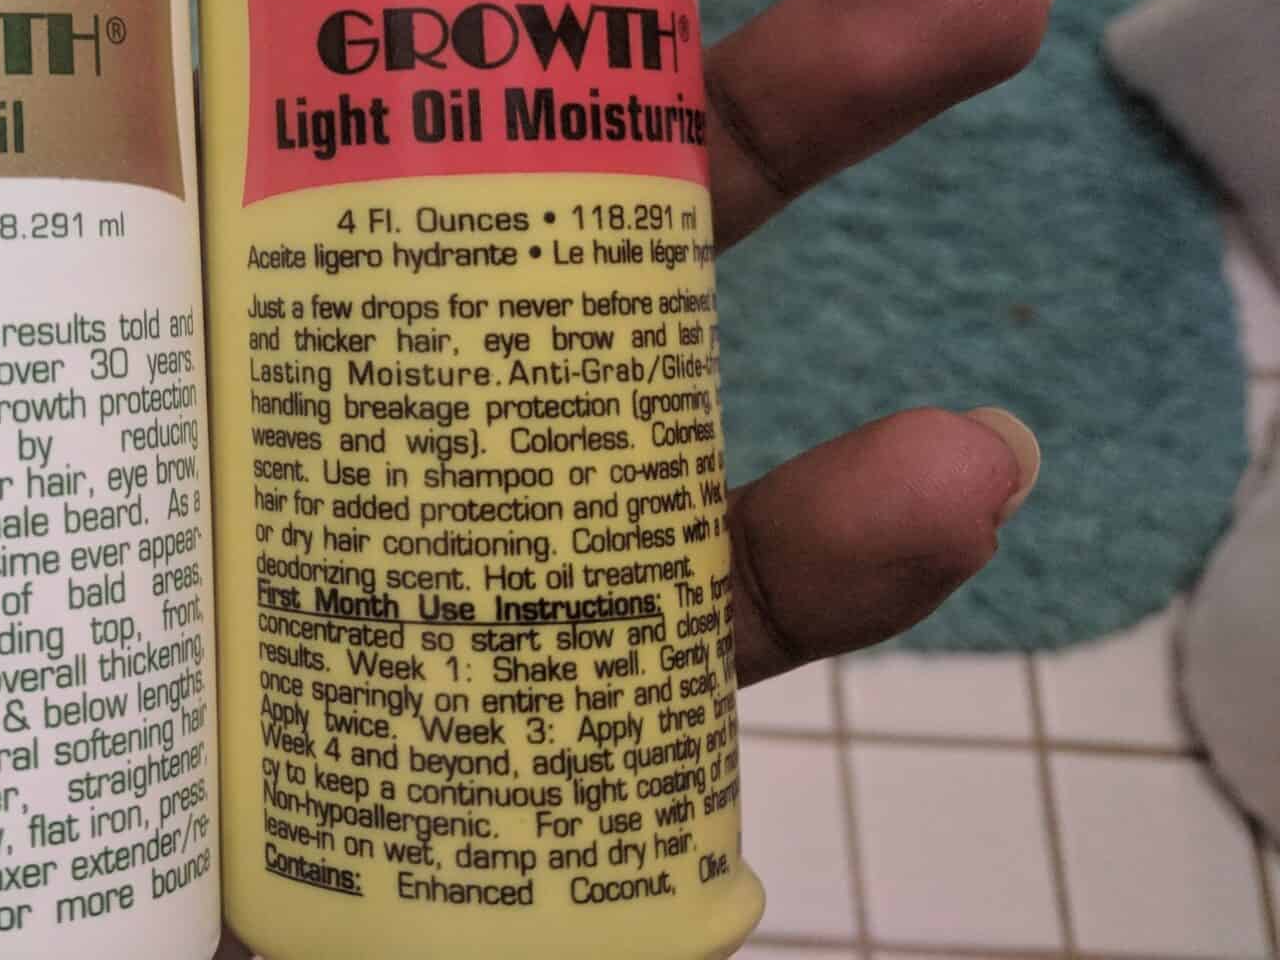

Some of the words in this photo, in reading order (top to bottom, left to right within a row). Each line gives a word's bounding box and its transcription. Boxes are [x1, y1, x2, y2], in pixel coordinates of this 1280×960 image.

[275, 95, 391, 160] Light
[413, 88, 481, 143] Oil
[505, 86, 706, 148] Moisturize
[99, 212, 125, 236] ml
[337, 209, 356, 234] 4
[369, 208, 400, 234] Fl.
[416, 207, 529, 233] Ounces
[572, 204, 673, 230] 118.291
[248, 244, 305, 270] Aceite
[314, 243, 382, 275] ligero
[393, 242, 517, 274] hydrante
[593, 239, 643, 264] huile
[651, 239, 688, 270] léger
[2, 313, 106, 347] results
[119, 308, 159, 340] told
[248, 293, 285, 319] Just
[361, 294, 439, 325] drops
[499, 298, 573, 318] never
[582, 291, 652, 317] before
[295, 328, 376, 352] thicker
[397, 328, 459, 356] hair,
[552, 324, 614, 351] brow
[250, 358, 331, 391] Lasting
[348, 360, 501, 386] Moisture.
[100, 379, 196, 425] protection
[250, 389, 331, 425] handling
[344, 394, 469, 427] breakage
[486, 392, 620, 426] protection
[122, 415, 197, 452] reducing
[252, 427, 322, 450] weaves
[407, 428, 486, 461] wigs).
[511, 424, 634, 454] Colorless.
[254, 459, 308, 482] scent.
[323, 459, 370, 485] Use
[424, 463, 553, 493] shampoo
[610, 453, 688, 483] co-wash
[65, 495, 148, 533] beard.
[254, 485, 287, 512] hair
[294, 489, 324, 516] for
[333, 494, 409, 520] added
[421, 495, 562, 527] protection
[573, 492, 618, 520] and
[627, 485, 695, 522] growth.
[71, 541, 130, 571] ever
[282, 522, 312, 554] dry
[324, 525, 370, 552] hair
[383, 530, 556, 562] conditioning.
[573, 525, 674, 553] Colorless
[68, 572, 125, 610] bald
[256, 552, 375, 593] deodorizing
[386, 567, 470, 590] scent.
[485, 564, 536, 590] Hot
[546, 563, 573, 589] oil
[584, 556, 694, 588] treatment.
[257, 578, 301, 609] First
[316, 587, 398, 618] Month
[419, 594, 475, 621] Use
[496, 591, 661, 621] Instructions:
[258, 613, 403, 649] concentrated
[472, 629, 541, 651] start
[557, 621, 614, 650] slow
[628, 623, 666, 646] and
[259, 641, 330, 672] results.
[347, 649, 426, 680] Week
[493, 656, 577, 683] Shake
[594, 649, 645, 679] well.
[44, 692, 127, 728] below
[260, 671, 303, 696] once
[312, 680, 422, 718] sparingly
[482, 687, 564, 713] entire
[575, 683, 624, 711] hair
[634, 678, 672, 706] and
[261, 694, 309, 733] Apply
[324, 710, 397, 739] twice.
[420, 716, 505, 744] Week
[578, 713, 643, 748] Apply
[55, 720, 173, 766] softening
[261, 720, 316, 758] Week
[351, 743, 398, 770] and
[410, 744, 518, 781] beyond,
[533, 748, 613, 780] adjust
[315, 762, 369, 802] keep
[408, 780, 562, 807] continuous
[573, 778, 628, 811] light
[30, 814, 79, 847] flat
[264, 781, 499, 840] Non-hypoallergenic.
[536, 811, 583, 838] For
[599, 812, 641, 835] use
[655, 795, 695, 827] with
[264, 808, 334, 851] leave-in
[384, 840, 441, 870] wet,
[456, 843, 536, 876] damp
[548, 840, 597, 869] and
[608, 838, 646, 869] dry
[57, 884, 133, 923] more
[151, 848, 210, 899] bounce
[265, 841, 360, 890] Contains:
[399, 871, 533, 905] Enhanced
[571, 872, 676, 904] Coconut,
